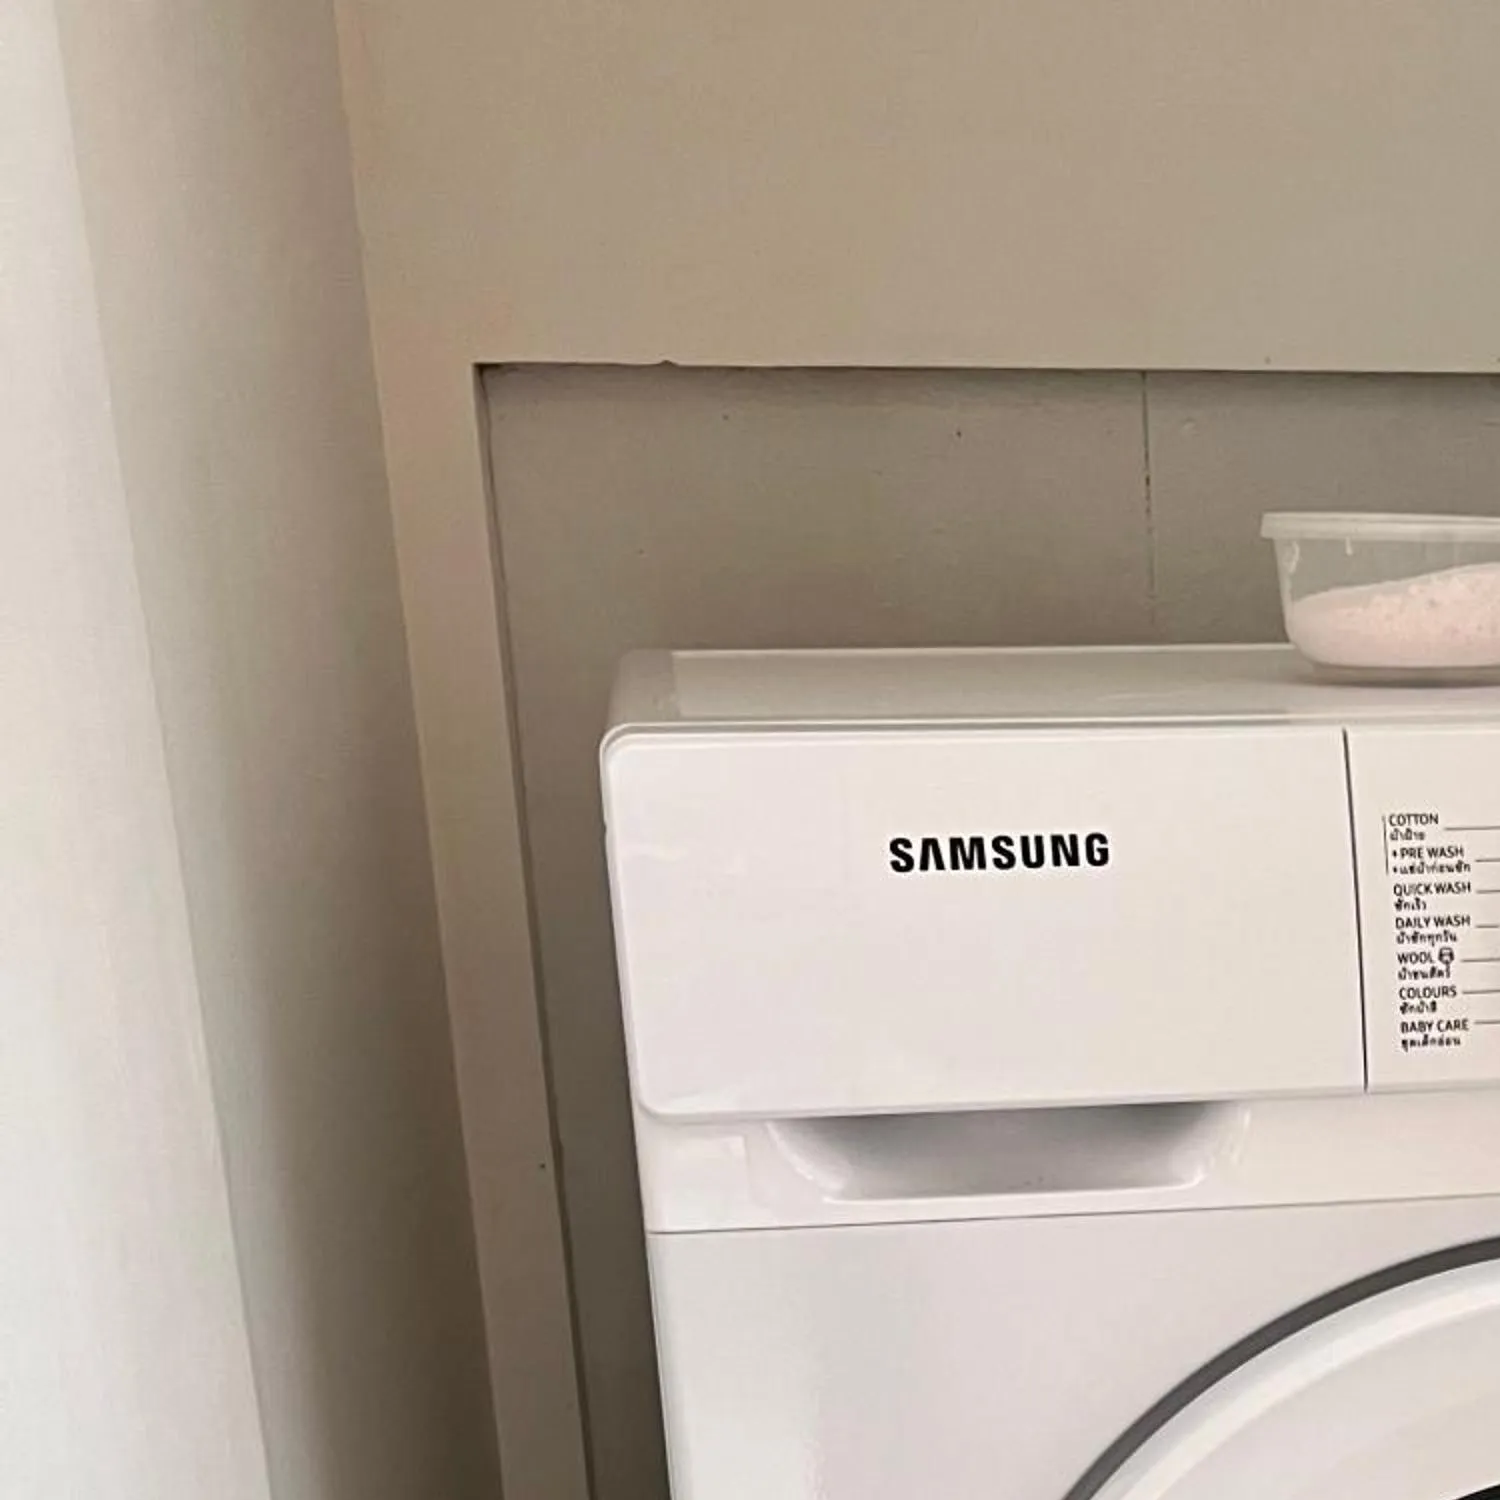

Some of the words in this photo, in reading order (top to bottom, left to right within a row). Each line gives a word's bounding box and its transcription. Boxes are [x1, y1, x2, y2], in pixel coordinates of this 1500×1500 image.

[1388, 813, 1439, 826] COTTON
[889, 832, 1110, 873] SAMSUNG
[1400, 847, 1424, 859] PRE
[1426, 845, 1465, 858] WASH
[1393, 882, 1432, 896] QUICK
[1434, 881, 1471, 894] WASH
[1395, 916, 1431, 930] DAILY
[1433, 914, 1471, 928] WASH
[1397, 951, 1434, 964] WOOL
[1399, 985, 1457, 1000] COLOURS
[1401, 1020, 1434, 1034] BABY
[1437, 1018, 1469, 1032] CARE
